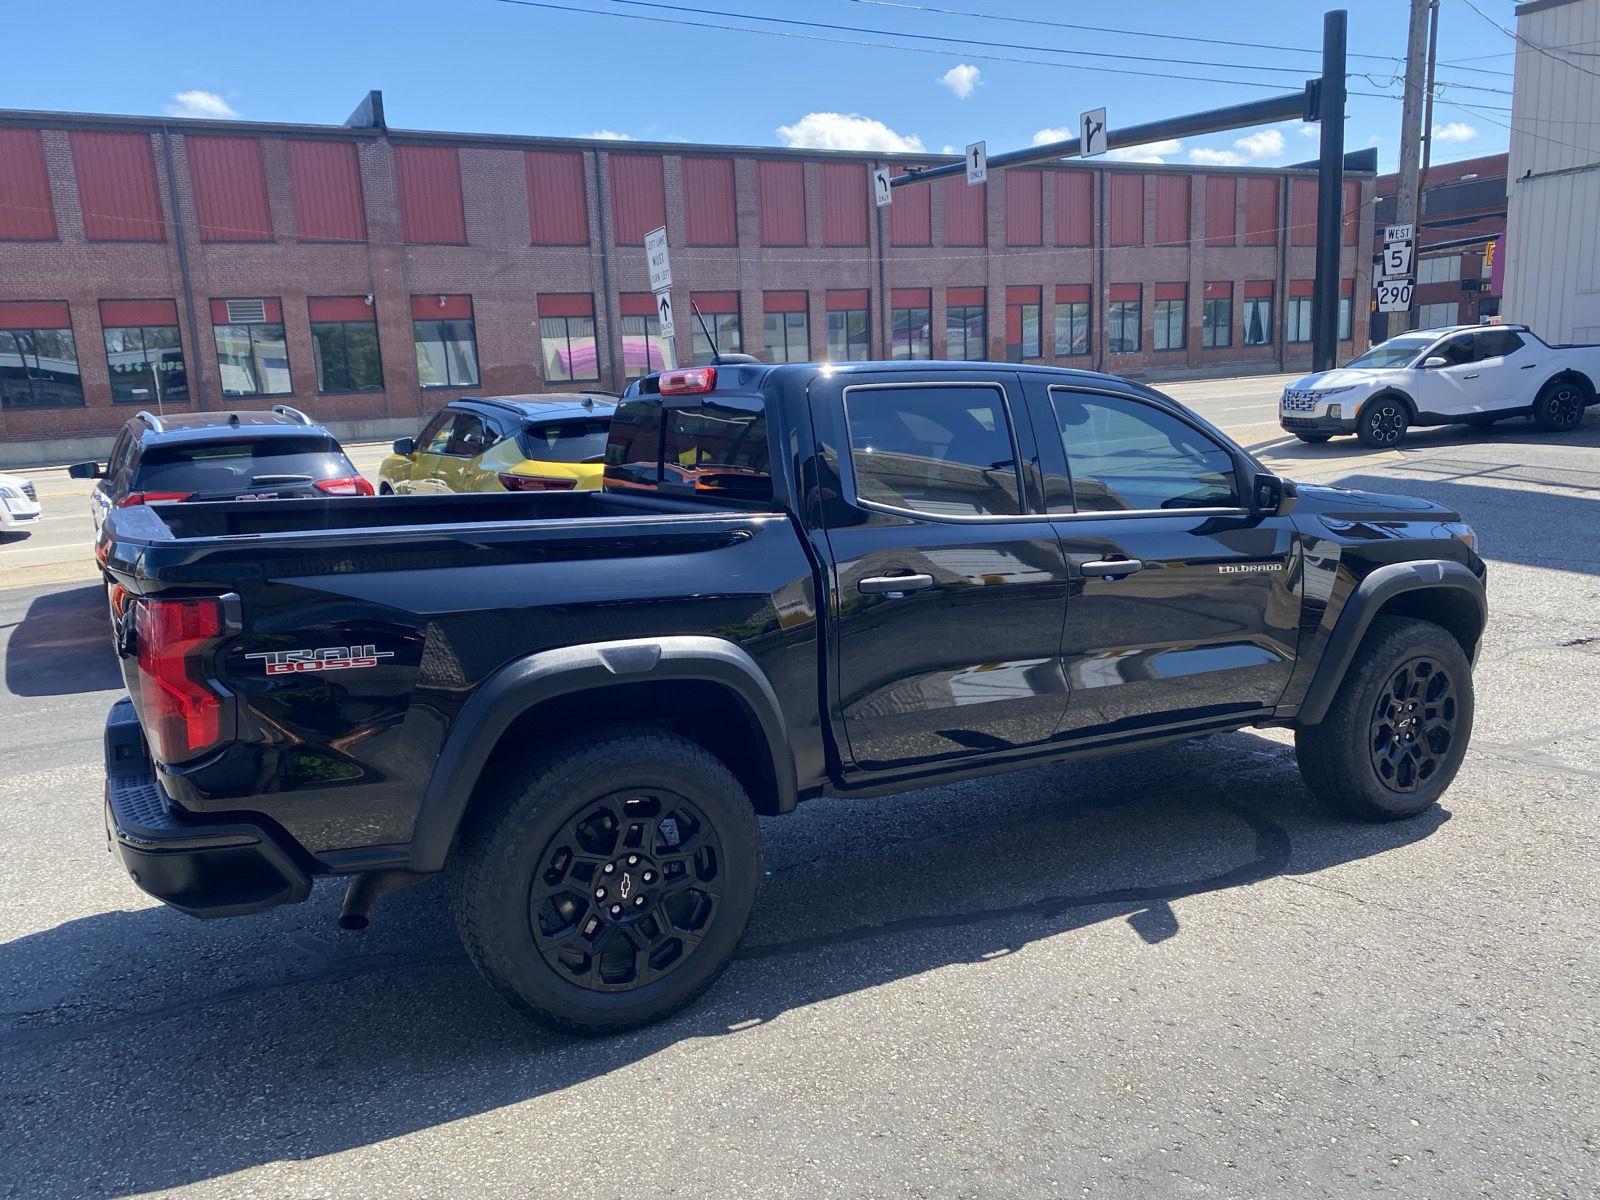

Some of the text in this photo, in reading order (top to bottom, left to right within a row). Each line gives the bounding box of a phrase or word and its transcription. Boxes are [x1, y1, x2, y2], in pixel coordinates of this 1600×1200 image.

[1388, 228, 1410, 239] WEST
[1391, 250, 1403, 268] 5
[1380, 286, 1410, 304] 290
[1218, 563, 1282, 574] COLORADO
[245, 644, 394, 664] TRAIL
[266, 656, 377, 675] BOSS
